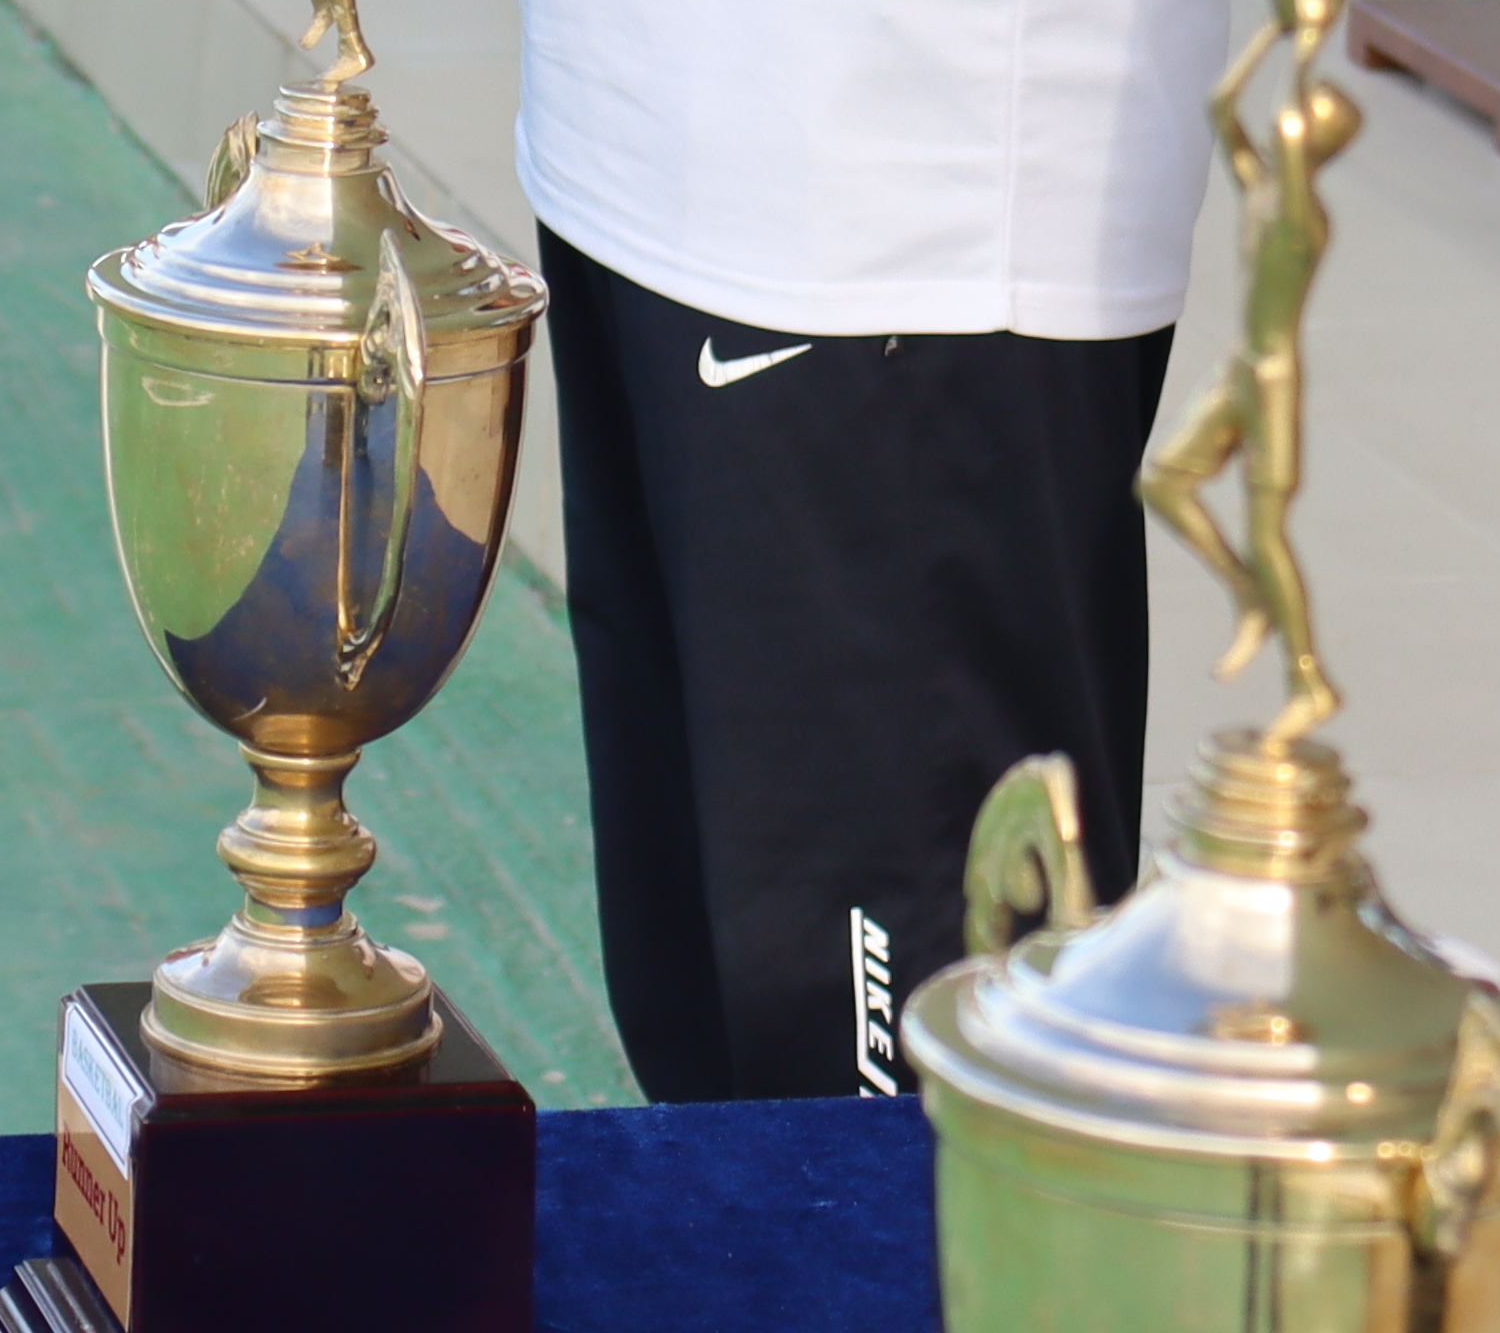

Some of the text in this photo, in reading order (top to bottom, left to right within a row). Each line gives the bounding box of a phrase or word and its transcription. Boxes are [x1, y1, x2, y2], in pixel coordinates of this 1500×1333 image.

[863, 917, 894, 1061] NIKE
[61, 1121, 126, 1266] Runner Up
